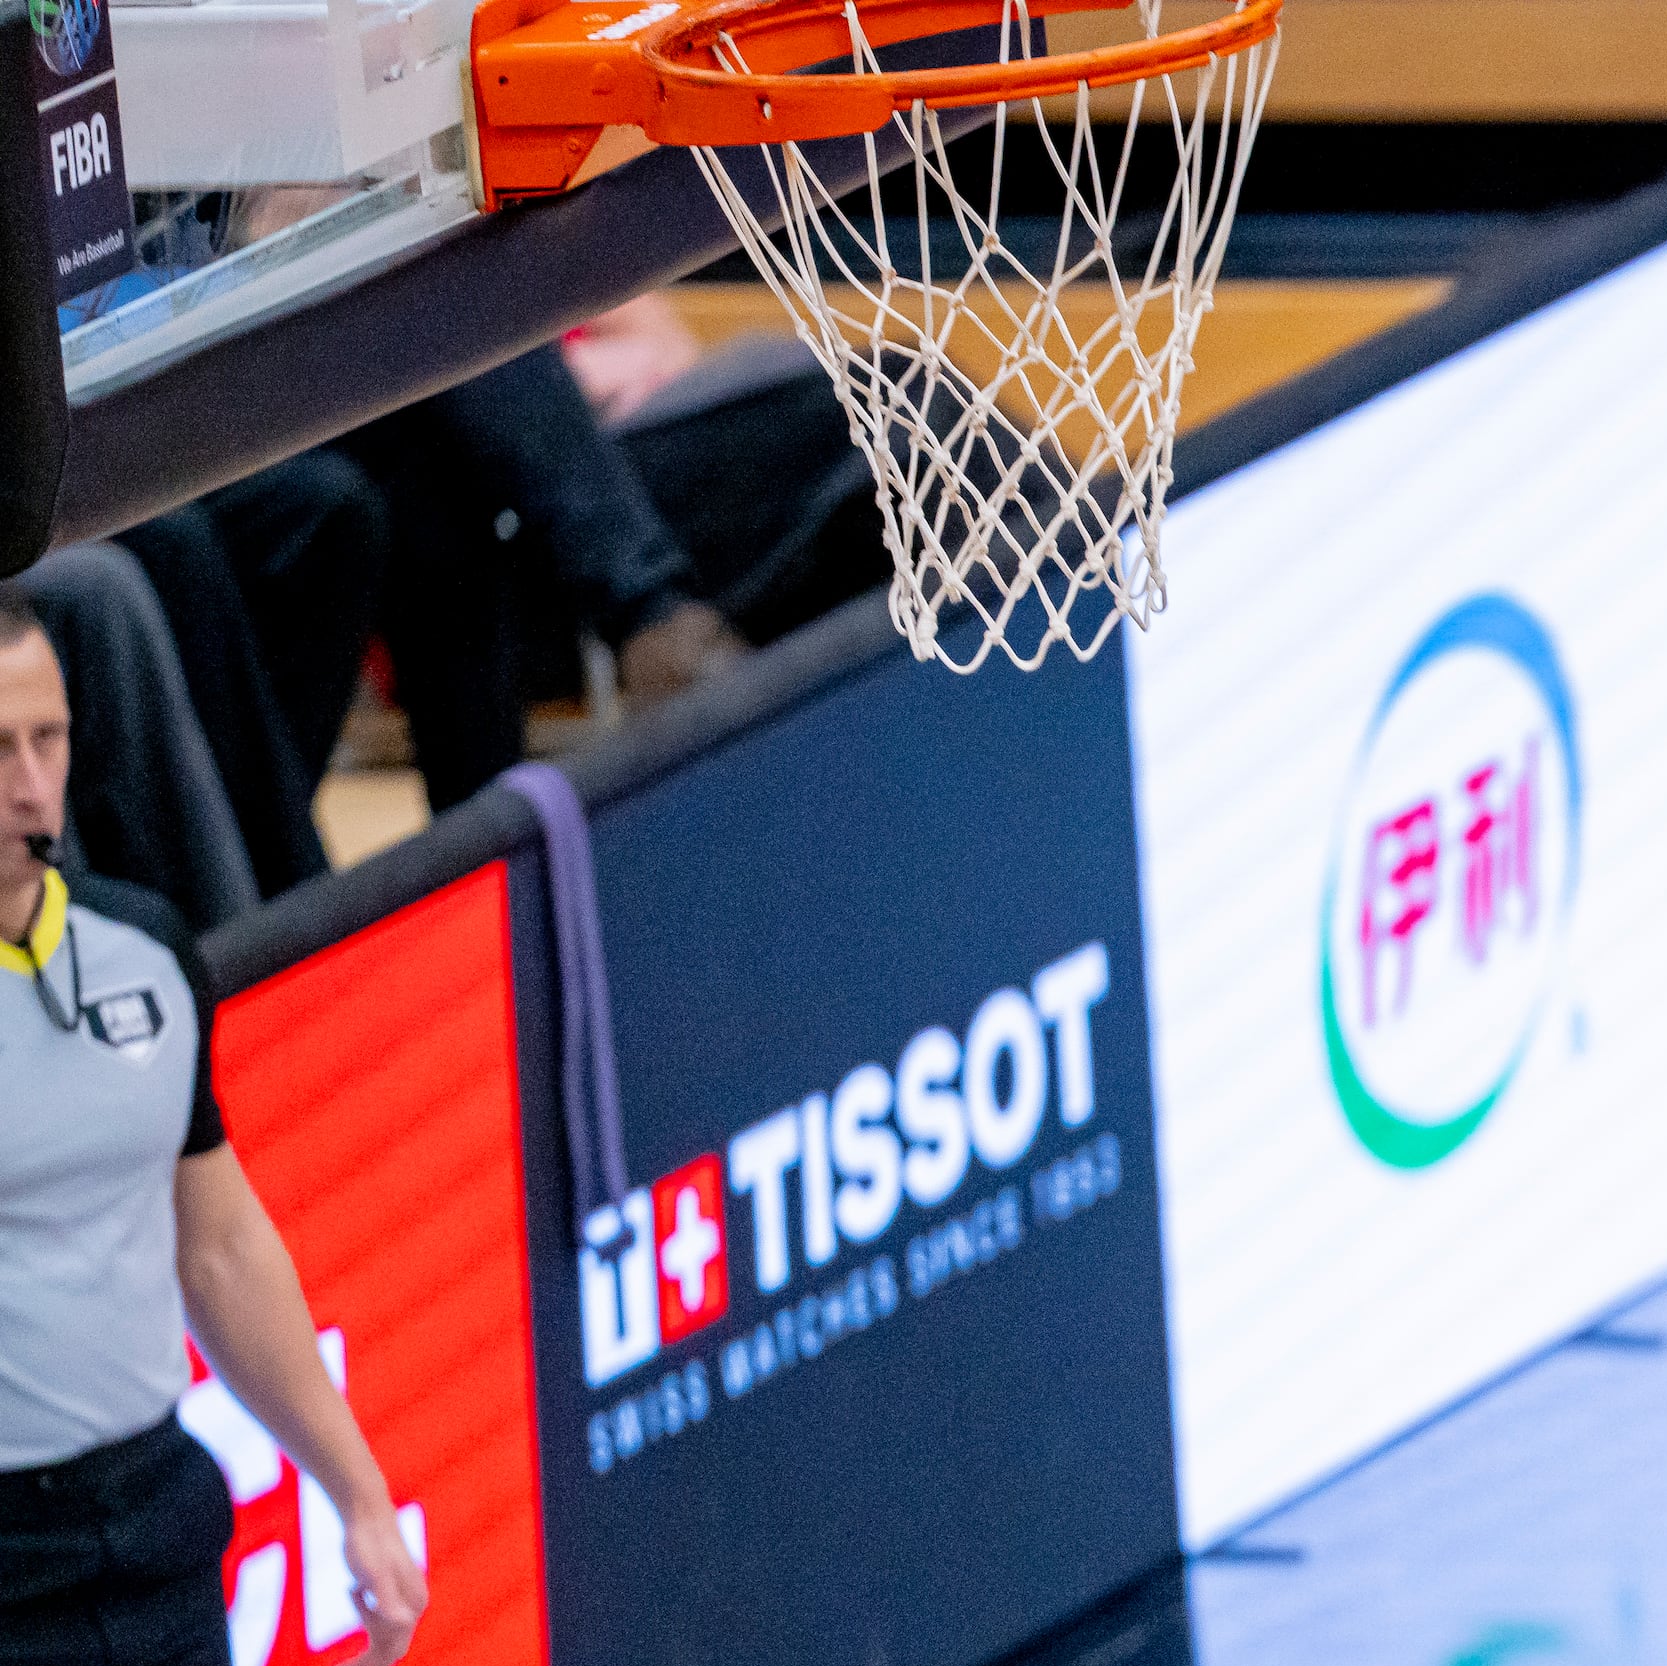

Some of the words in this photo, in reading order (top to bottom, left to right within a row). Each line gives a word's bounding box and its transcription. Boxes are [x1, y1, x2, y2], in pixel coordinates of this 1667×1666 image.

[51, 112, 111, 196] FIBA
[1358, 735, 1542, 1030] 伊利
[728, 940, 1109, 1293] TISSOT
